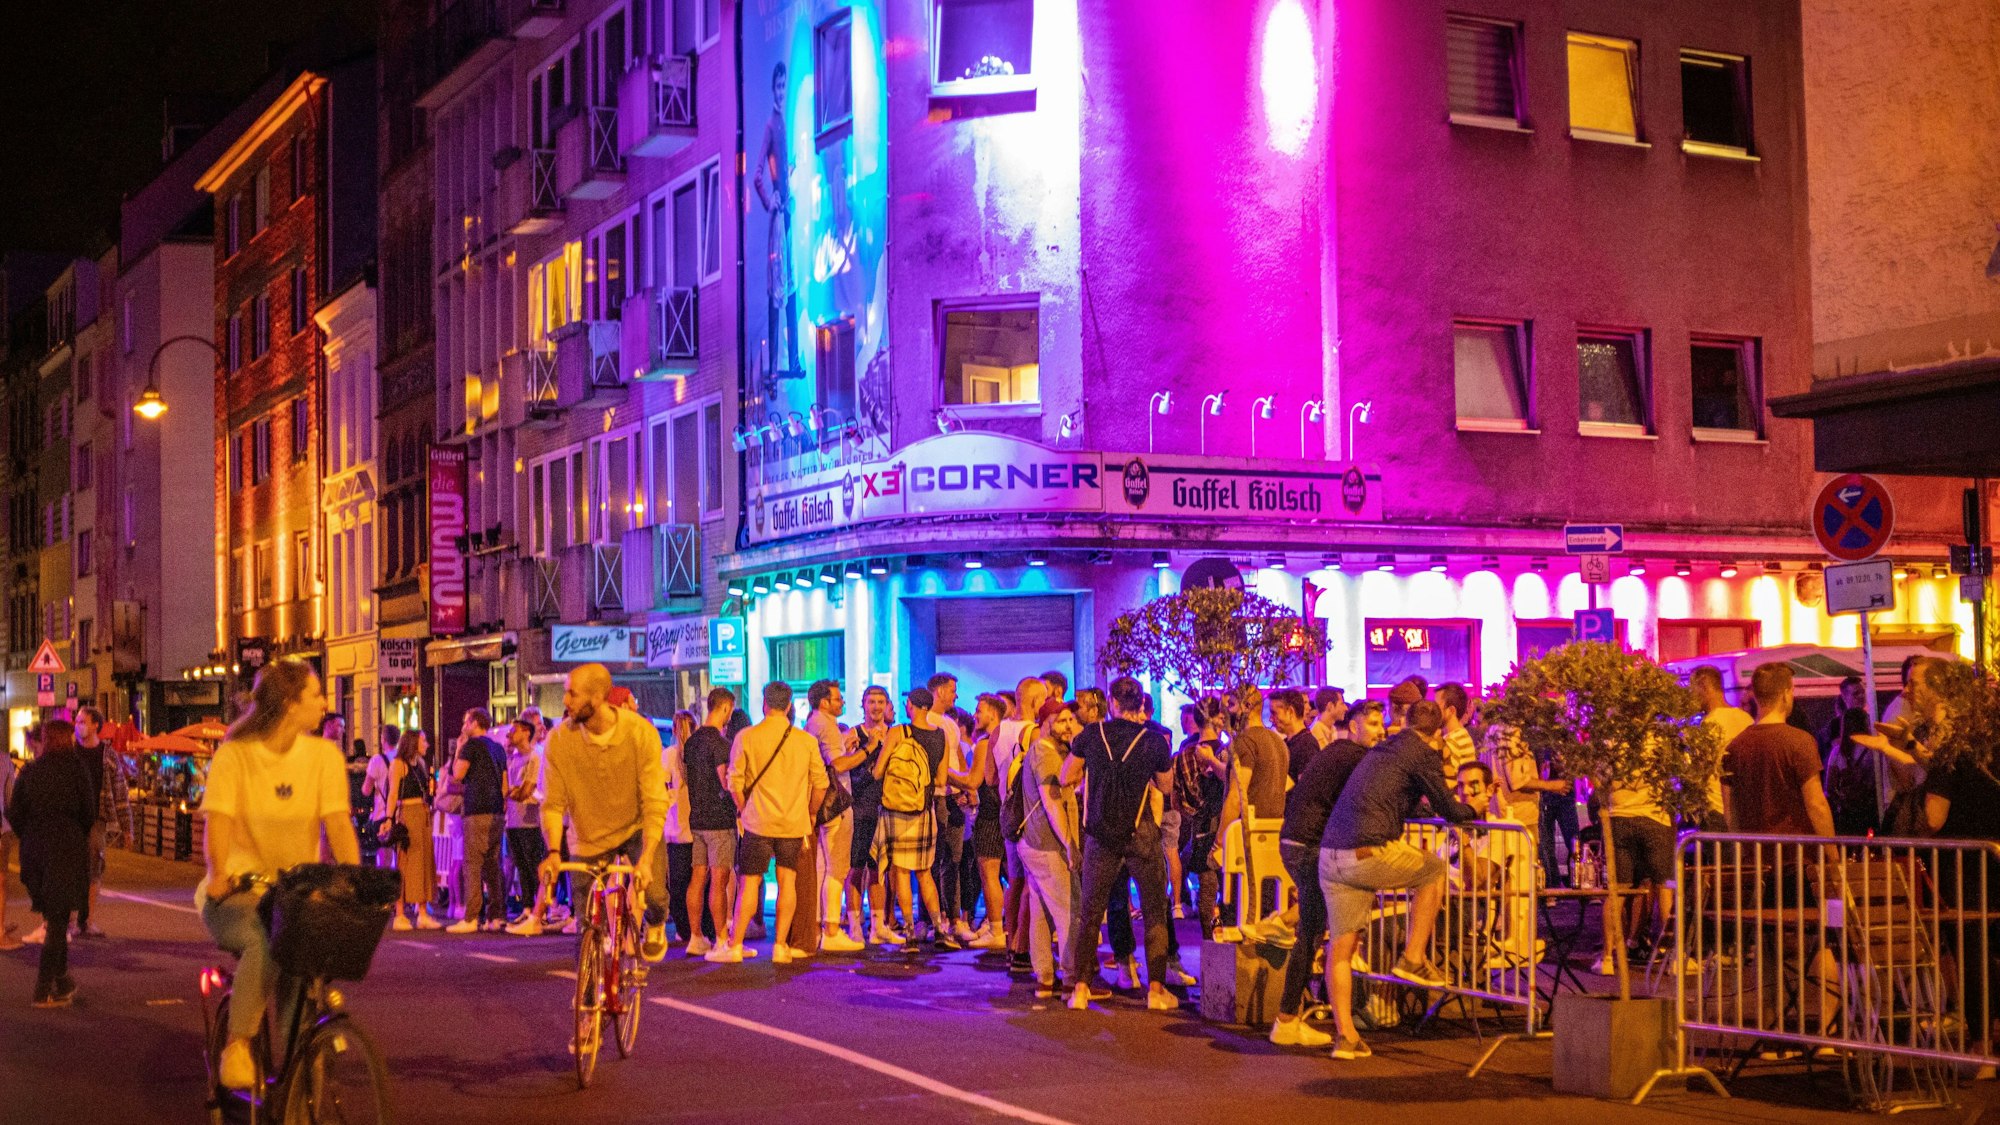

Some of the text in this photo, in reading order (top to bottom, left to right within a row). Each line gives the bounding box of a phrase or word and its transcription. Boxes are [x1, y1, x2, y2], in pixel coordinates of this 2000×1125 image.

[431, 449, 464, 461] Gilden
[432, 472, 454, 490] die
[911, 463, 1100, 493] CORNER
[1173, 477, 1321, 514] Gaffel Kölsch
[772, 491, 834, 532] Gaffel Kölsch
[432, 493, 464, 606] mumu
[1568, 534, 1607, 545] Einbahnstraße
[717, 623, 735, 651] P
[1581, 614, 1602, 642] P
[555, 628, 628, 658] Gerny's
[389, 657, 412, 669] to go
[41, 675, 51, 691] P
